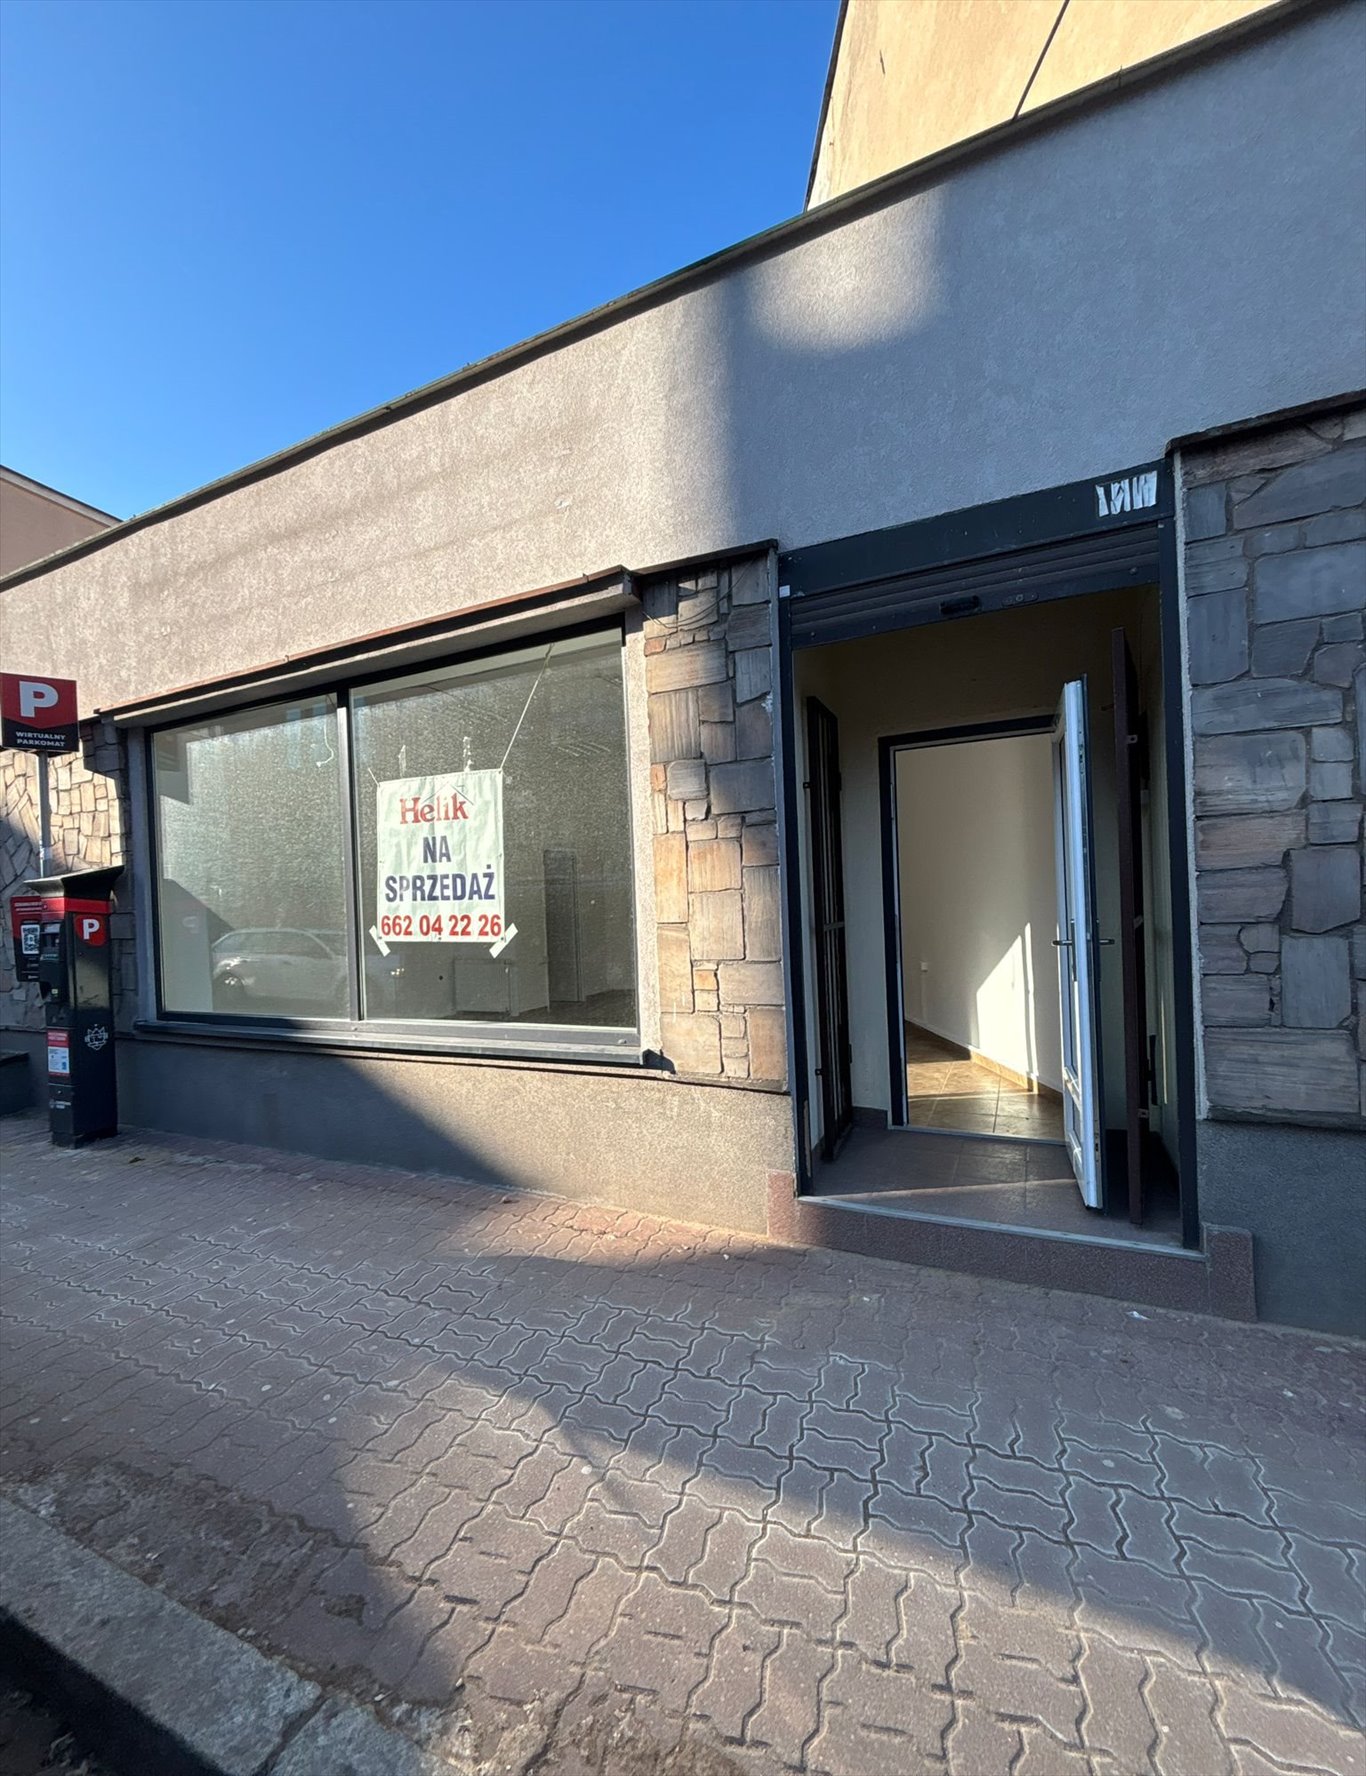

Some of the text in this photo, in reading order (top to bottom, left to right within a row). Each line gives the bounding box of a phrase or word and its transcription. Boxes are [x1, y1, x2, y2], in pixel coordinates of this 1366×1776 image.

[19, 681, 58, 717] P
[16, 731, 65, 740] WIRTUALNY
[17, 739, 65, 747] PARKOMAT
[400, 793, 468, 824] Helik
[423, 835, 451, 863] NA
[385, 864, 495, 902] SPRZEDAŻ
[83, 918, 100, 940] P
[381, 914, 502, 936] 662 04 22 26
